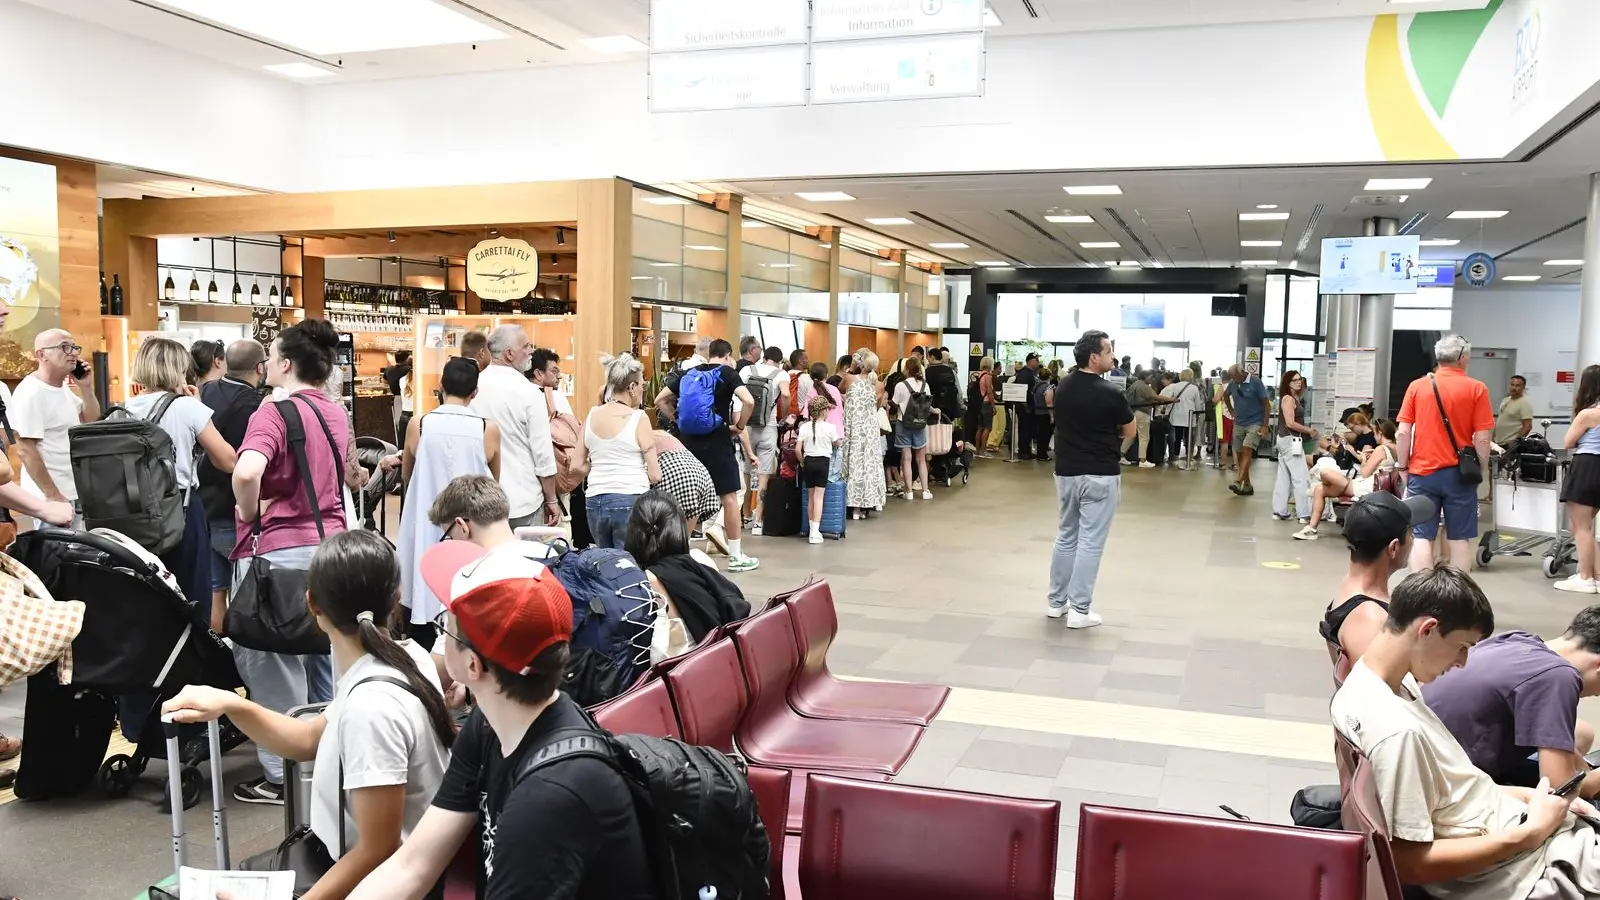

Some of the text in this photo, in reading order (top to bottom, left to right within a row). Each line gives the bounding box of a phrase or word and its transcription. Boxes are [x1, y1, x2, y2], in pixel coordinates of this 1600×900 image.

[848, 17, 914, 32] Information
[684, 25, 786, 44] Sicherheitskontrolle
[829, 80, 891, 95] Verwaltung
[475, 246, 531, 262] CARRETTAI FLY
